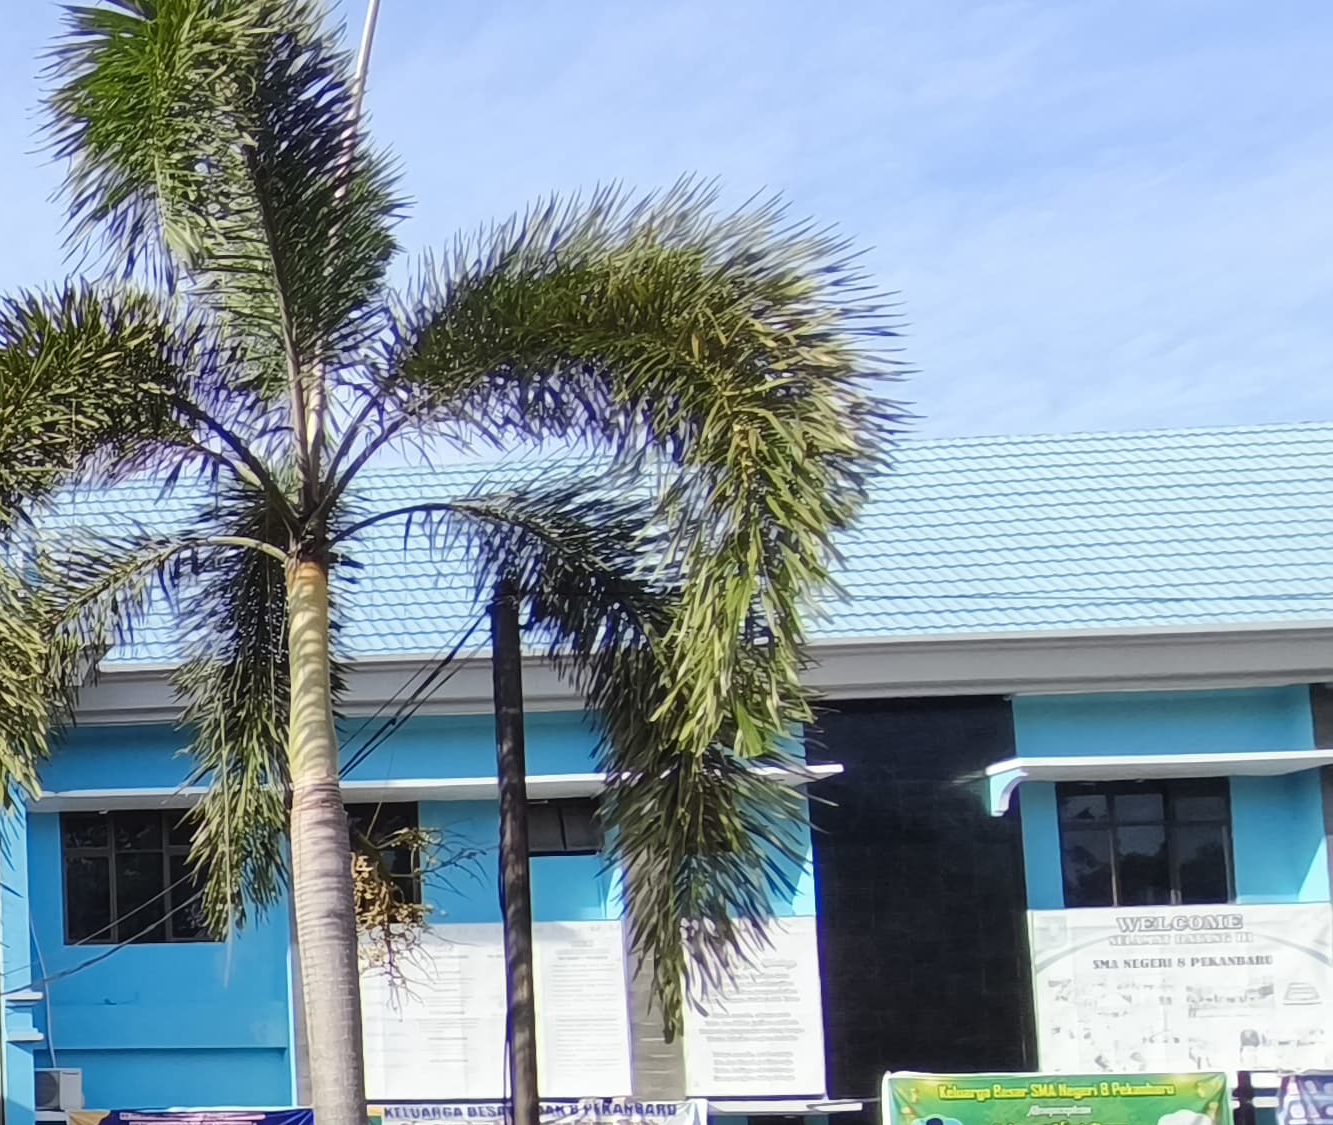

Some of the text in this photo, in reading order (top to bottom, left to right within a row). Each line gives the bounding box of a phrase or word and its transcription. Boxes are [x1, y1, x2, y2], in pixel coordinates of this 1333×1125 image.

[1116, 914, 1244, 933] WELCOME
[1092, 955, 1273, 970] SMA NEGERI 8 PEKANBARU
[937, 1081, 1175, 1102] Keluarga Besar SMA Negeri 8 Pekanbaru
[384, 1106, 463, 1119] KELUARGA
